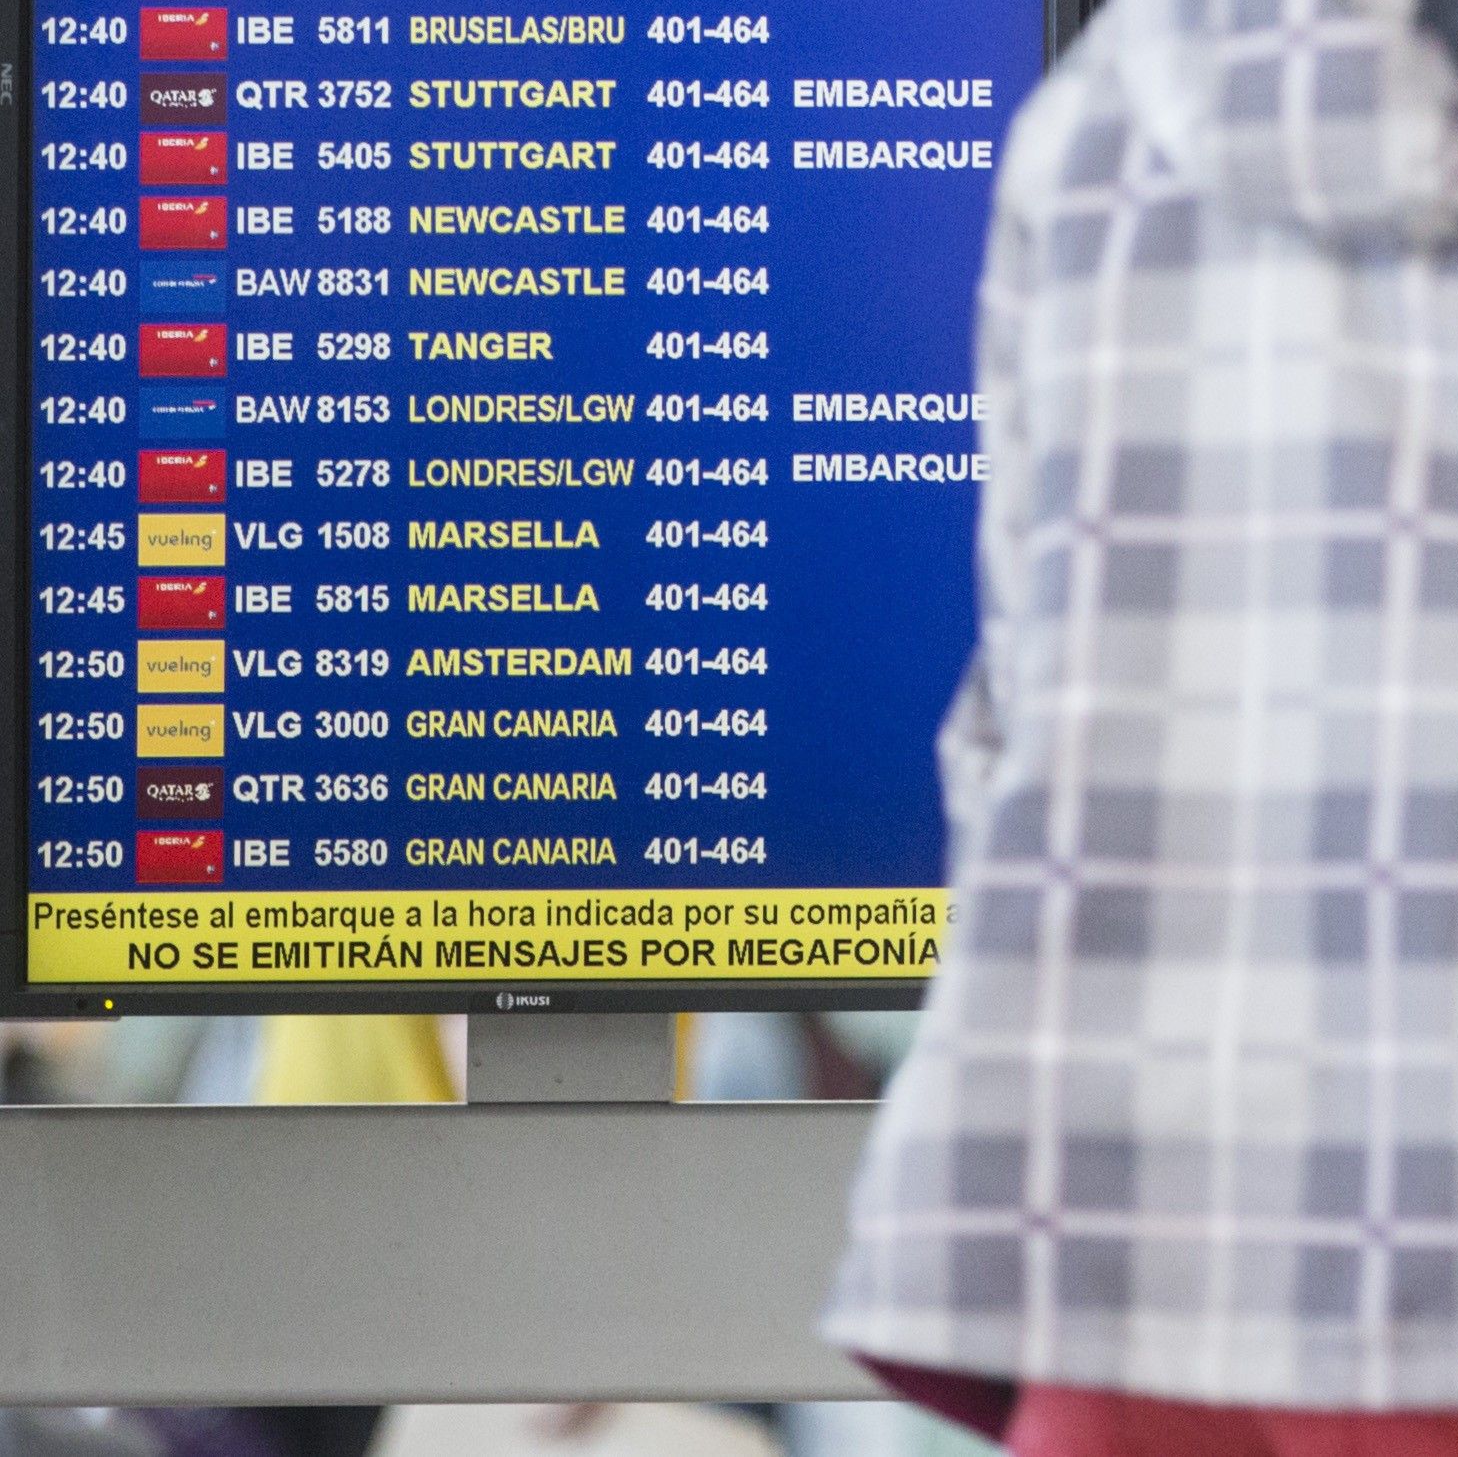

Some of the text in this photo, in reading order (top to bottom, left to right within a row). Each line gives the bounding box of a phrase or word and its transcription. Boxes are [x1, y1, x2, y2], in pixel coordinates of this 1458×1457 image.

[41, 79, 993, 110] 12:40 QTR 3752 STUTTGART 401-464 EMBARQUE
[39, 647, 768, 678] 12:50 VLG 8319 AMSTERDAM 401-464
[34, 897, 936, 935] Preséntese al embarque a la hora indicada por su compañía
[128, 932, 940, 970] NO SE EMITIRÁN MENSAJES POR MEGAFONÍA
[515, 995, 550, 1007] IKUSI
